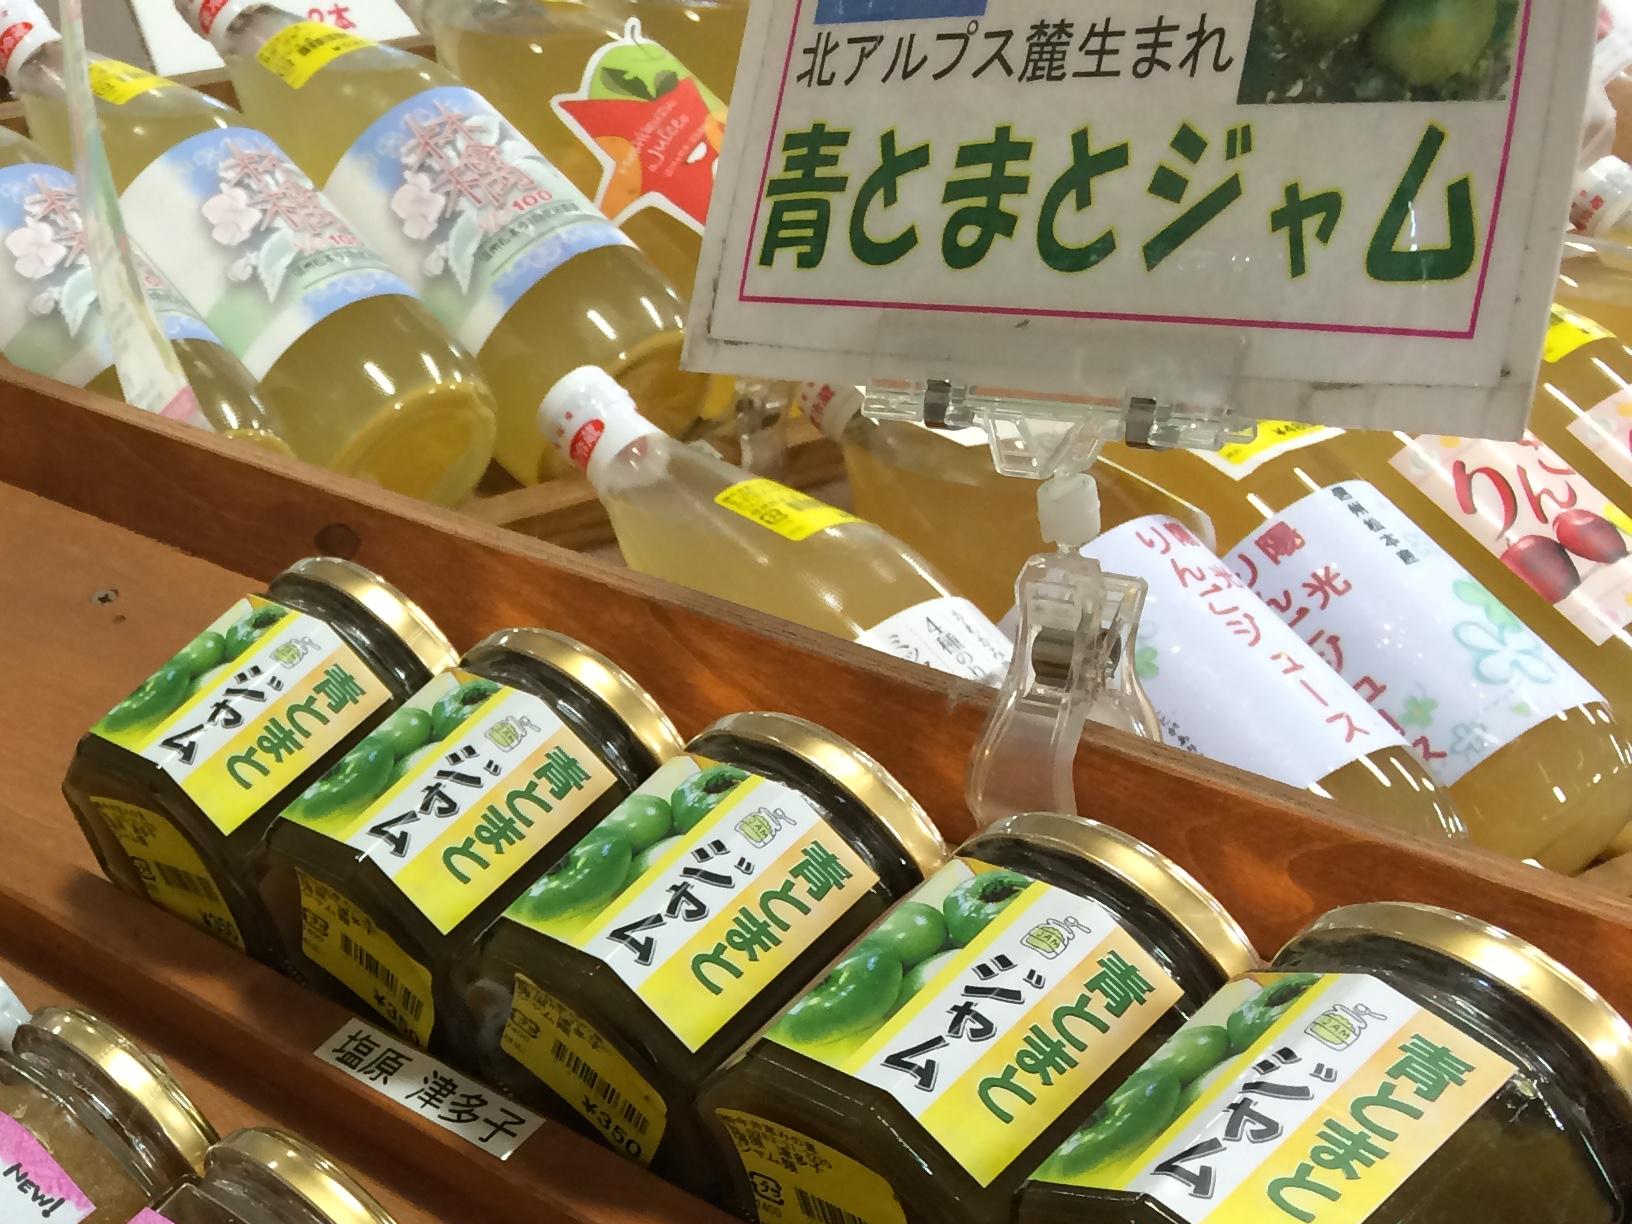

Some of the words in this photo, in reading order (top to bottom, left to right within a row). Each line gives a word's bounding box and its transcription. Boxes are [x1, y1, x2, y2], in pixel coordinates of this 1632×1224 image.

[795, 18, 1235, 90] 北アルプス麓生まれ
[756, 118, 1482, 286] 青とまとジャム
[157, 663, 285, 766] ジャム
[224, 662, 368, 791] 青とまと
[364, 743, 504, 859] ジャム
[441, 744, 594, 886] 青とまと
[608, 836, 757, 966] ジャム
[691, 834, 855, 997] 青とまと
[332, 1028, 414, 1085] 塩原
[405, 1070, 528, 1145] 津多子
[882, 952, 1047, 1094] ジャム
[975, 948, 1166, 1125] 青とまと
[580, 1093, 643, 1162] ¥350
[1150, 1044, 1340, 1202] ジャム
[1266, 1031, 1478, 1224] 青とまと
